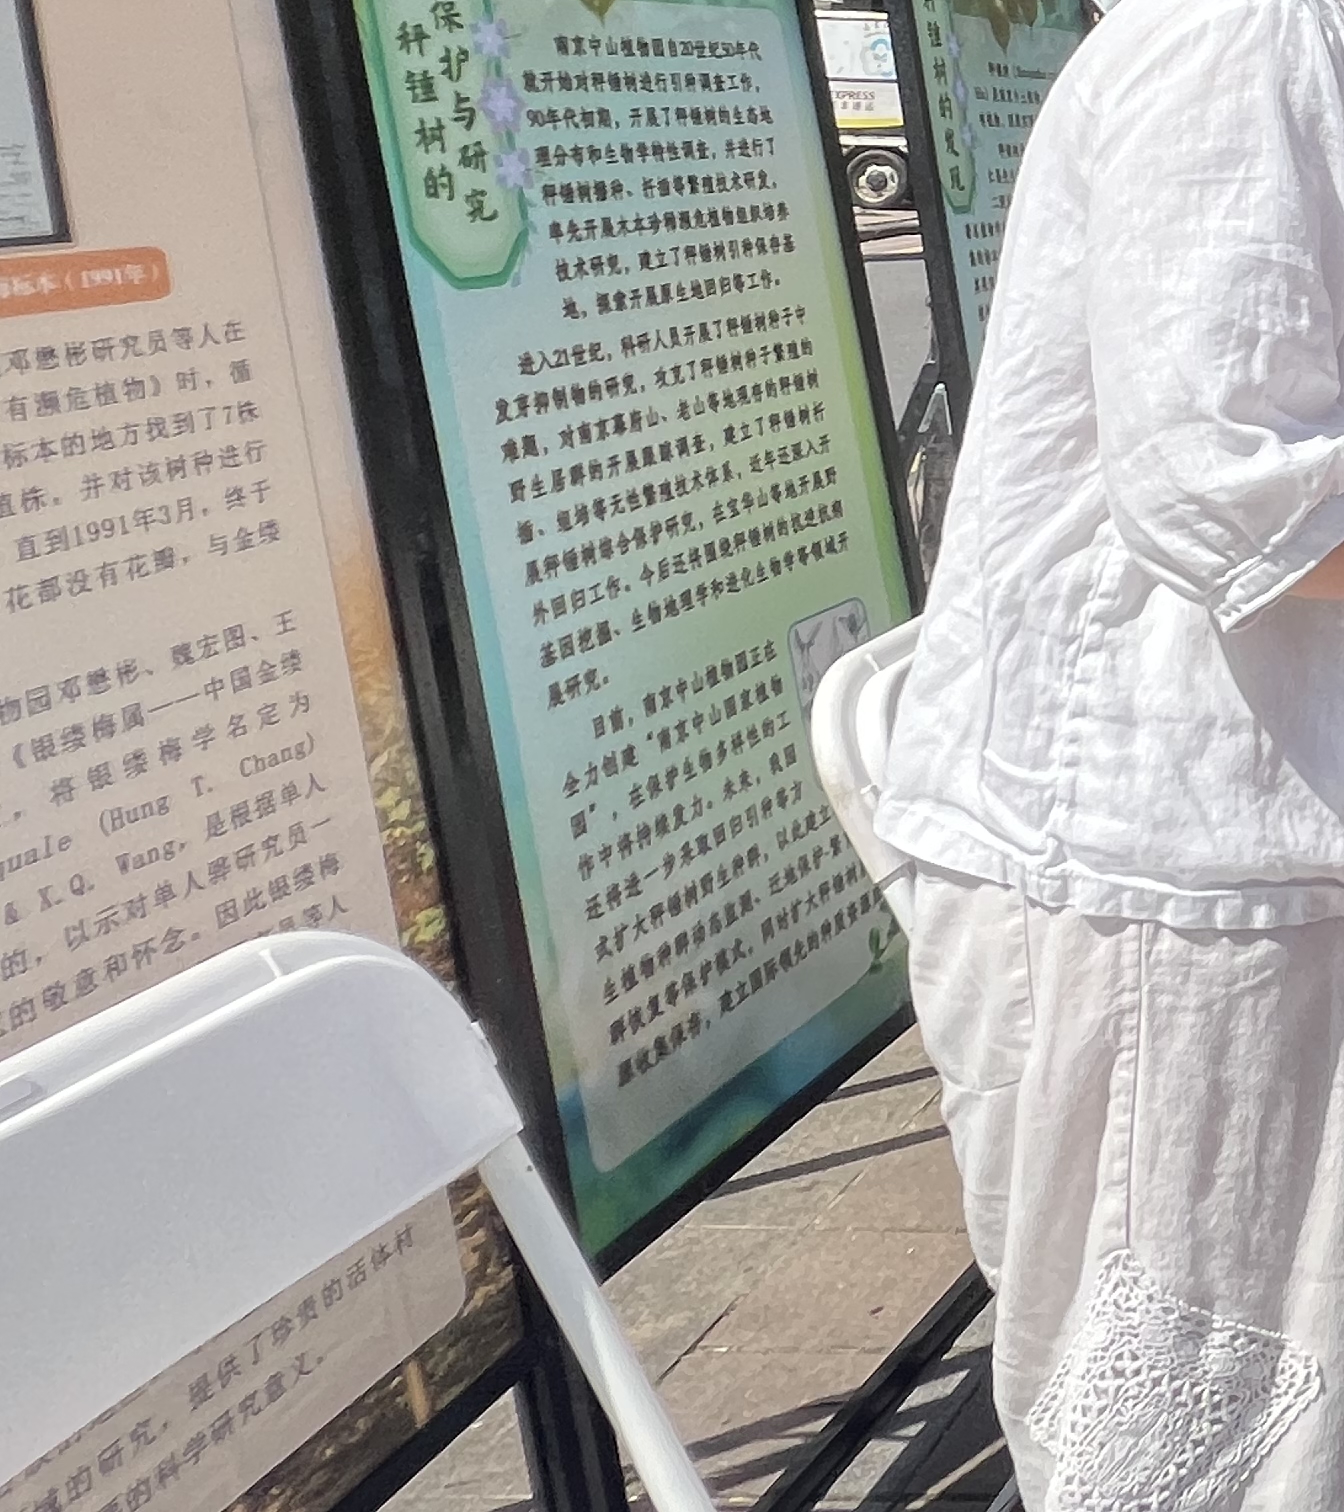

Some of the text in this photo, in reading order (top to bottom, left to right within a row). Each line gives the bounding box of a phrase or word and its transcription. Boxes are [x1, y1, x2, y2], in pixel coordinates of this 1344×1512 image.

[395, 20, 456, 201] 秤锤树的
[429, 0, 499, 223] 保护与研究
[547, 667, 609, 710] 展研究。
[99, 794, 171, 837] (Hung
[238, 731, 315, 779] Chang)
[0, 851, 340, 1038] 的敬意和怀念。因此银缕梅
[609, 861, 866, 1046] 群恢复等保护模式。同时扩大秤锤树
